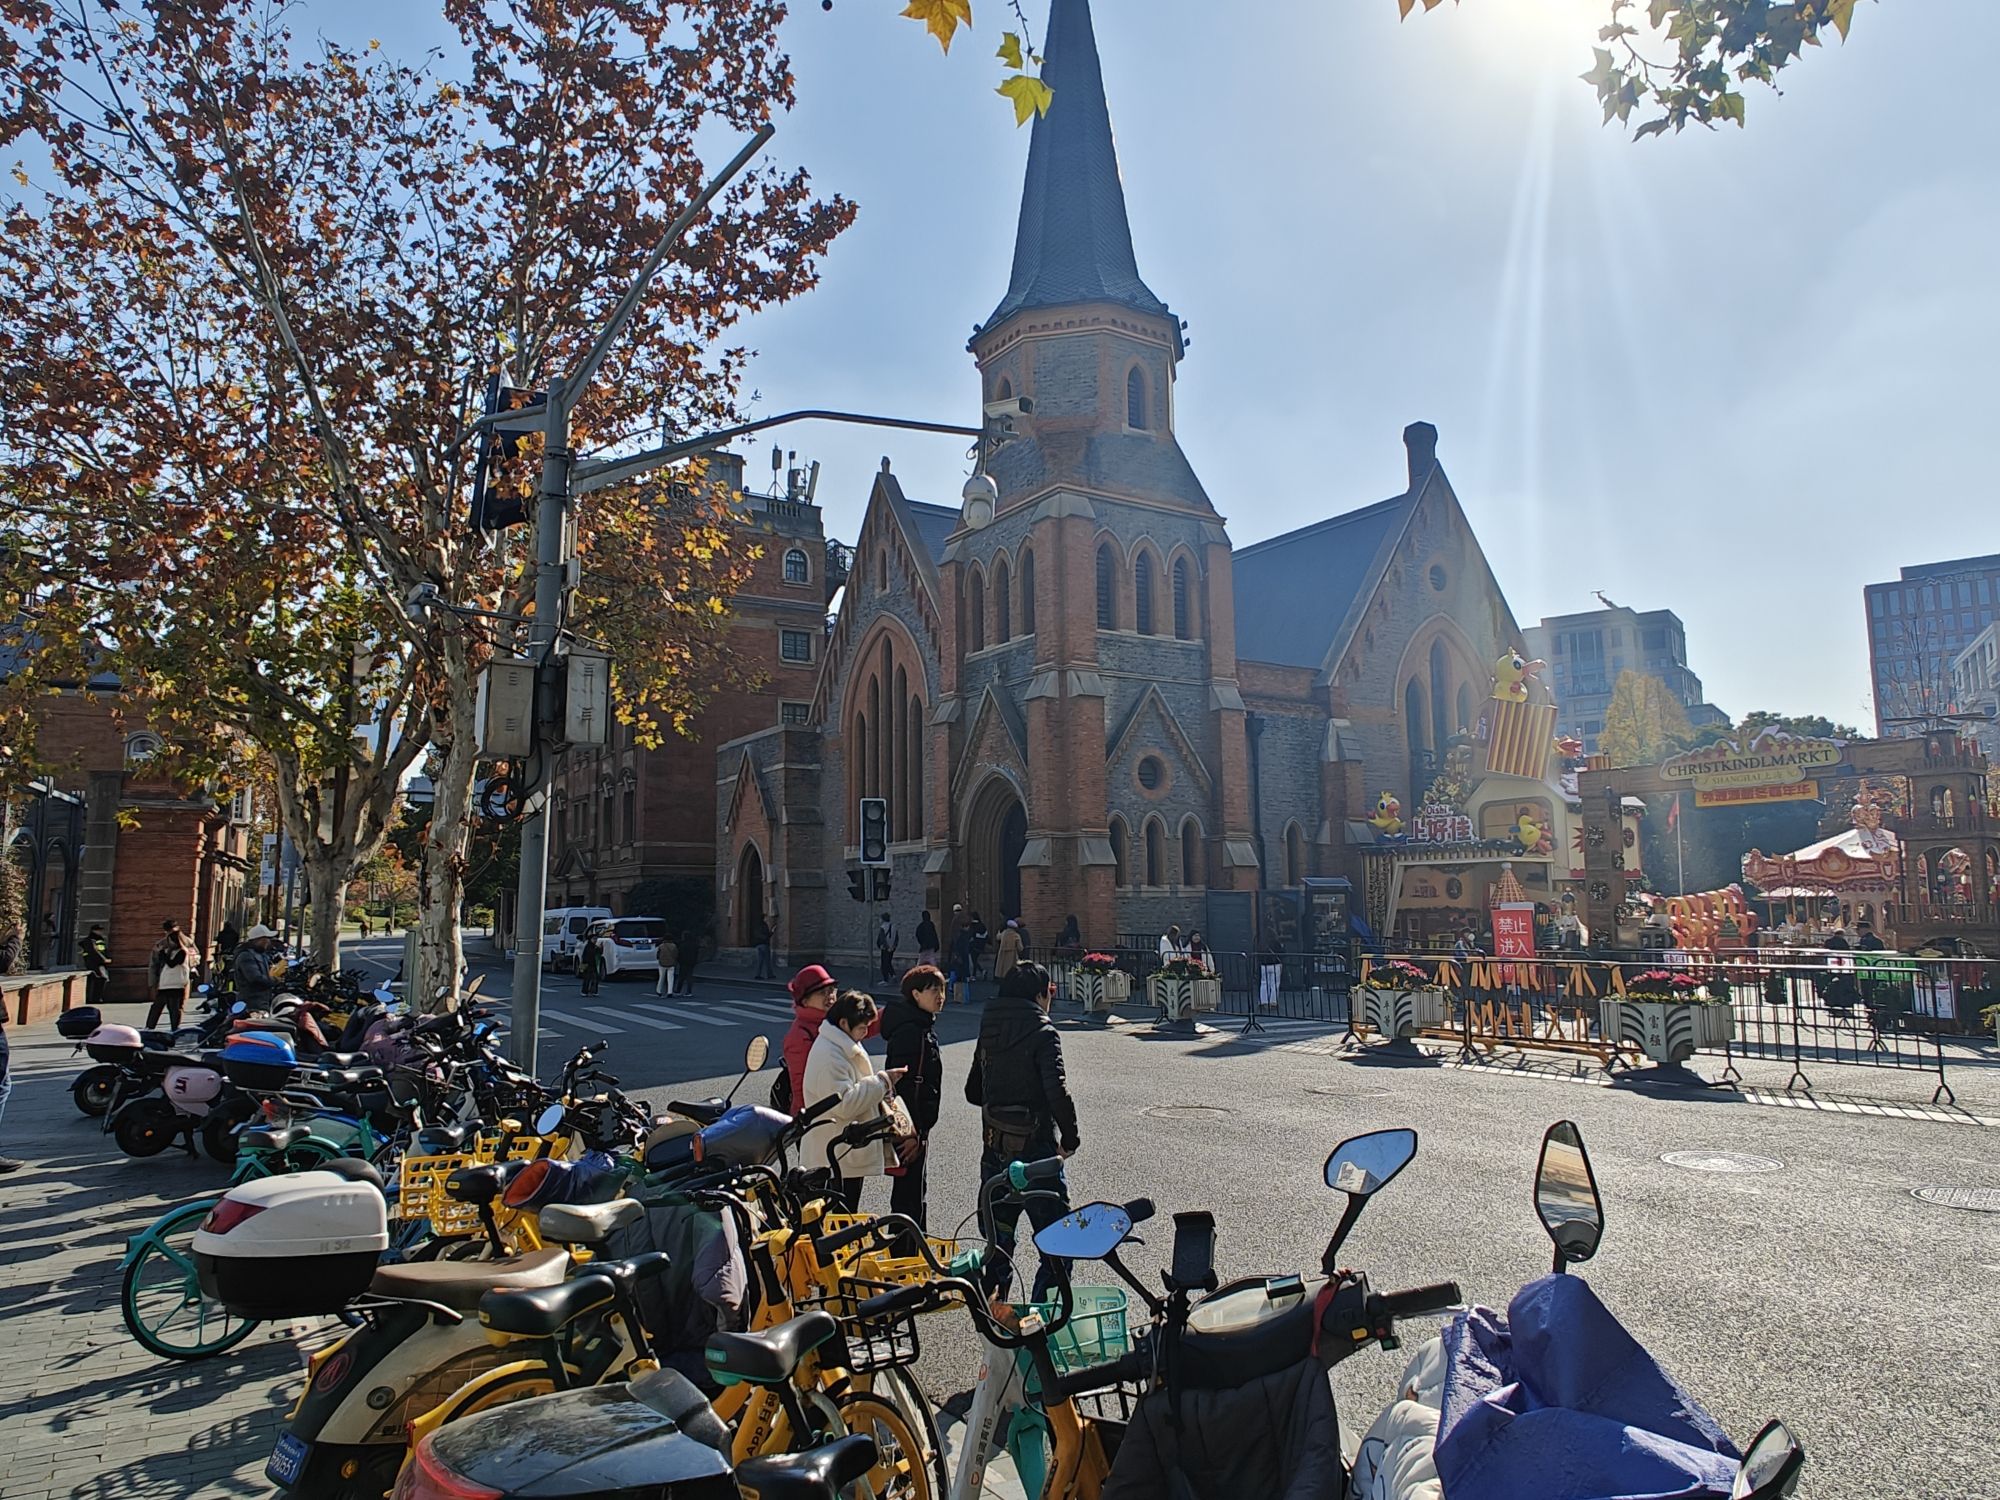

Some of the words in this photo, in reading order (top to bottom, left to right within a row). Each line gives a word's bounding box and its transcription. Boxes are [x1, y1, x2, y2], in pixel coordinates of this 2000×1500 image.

[1667, 750, 1832, 777] CHRISTKINDLMARKT
[1426, 804, 1448, 816] Oishi
[1408, 816, 1472, 843] 上好佳
[1498, 916, 1529, 935] 禁止
[1500, 938, 1531, 956] 进入
